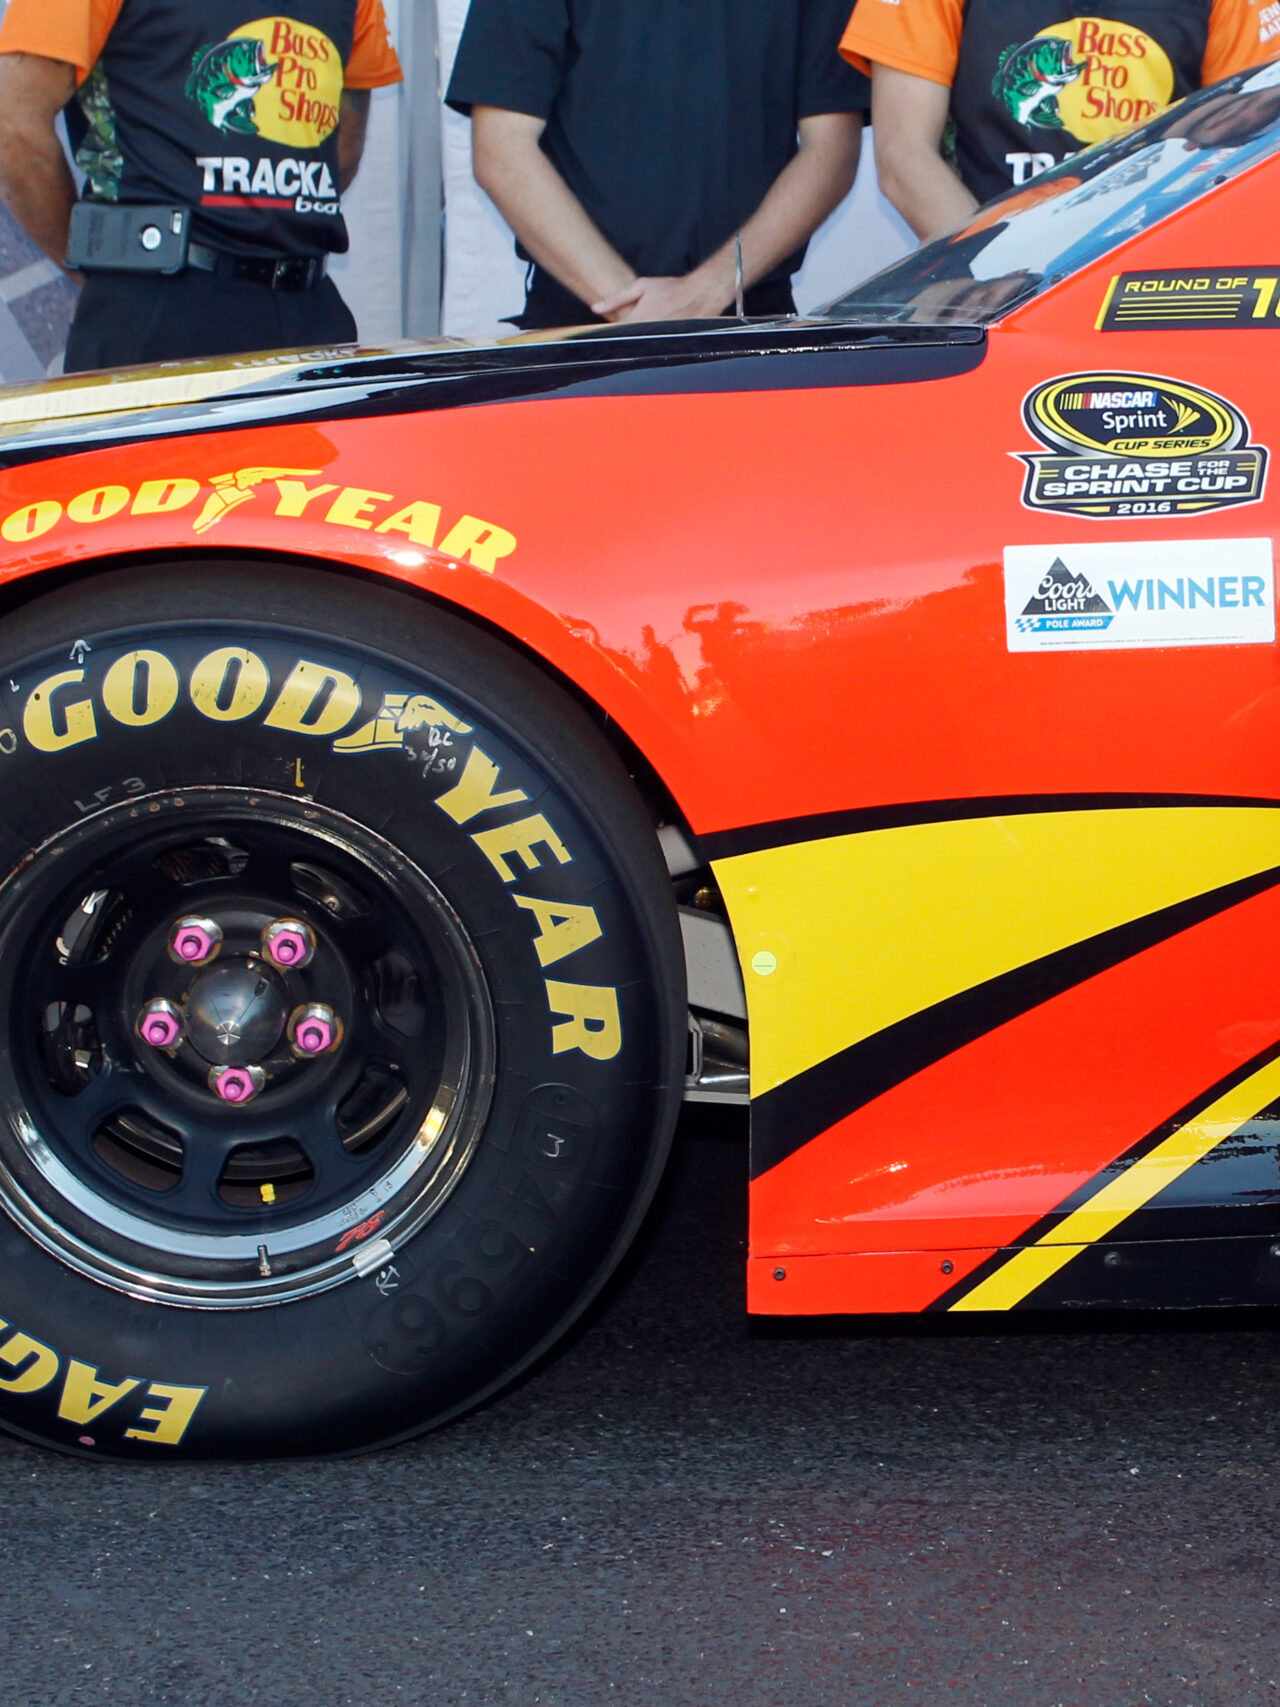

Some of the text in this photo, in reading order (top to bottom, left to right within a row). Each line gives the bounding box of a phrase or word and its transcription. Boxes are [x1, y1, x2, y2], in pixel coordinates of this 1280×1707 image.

[270, 20, 330, 63] Bass
[1077, 20, 1148, 59] Bass
[275, 56, 317, 91] Pro
[1082, 55, 1129, 89] Pro
[278, 88, 338, 134] Shops
[1124, 278, 1209, 293] ROUND
[1215, 277, 1249, 290] OF
[1089, 391, 1157, 410] NASCAR
[1102, 410, 1168, 433] Sprint
[1113, 438, 1213, 451] CUP SERIES
[1064, 461, 1193, 481] CHASE
[1197, 460, 1230, 469] FOR
[1197, 467, 1228, 476] THE
[1042, 475, 1248, 497] SPRINT CUP
[1116, 501, 1172, 515] 2016
[1036, 575, 1099, 599] Coors
[1107, 576, 1266, 612] WINNER
[1044, 598, 1087, 612] LIGHT
[1046, 617, 1104, 628] POLE AWARD
[0, 1316, 207, 1446] EAG
